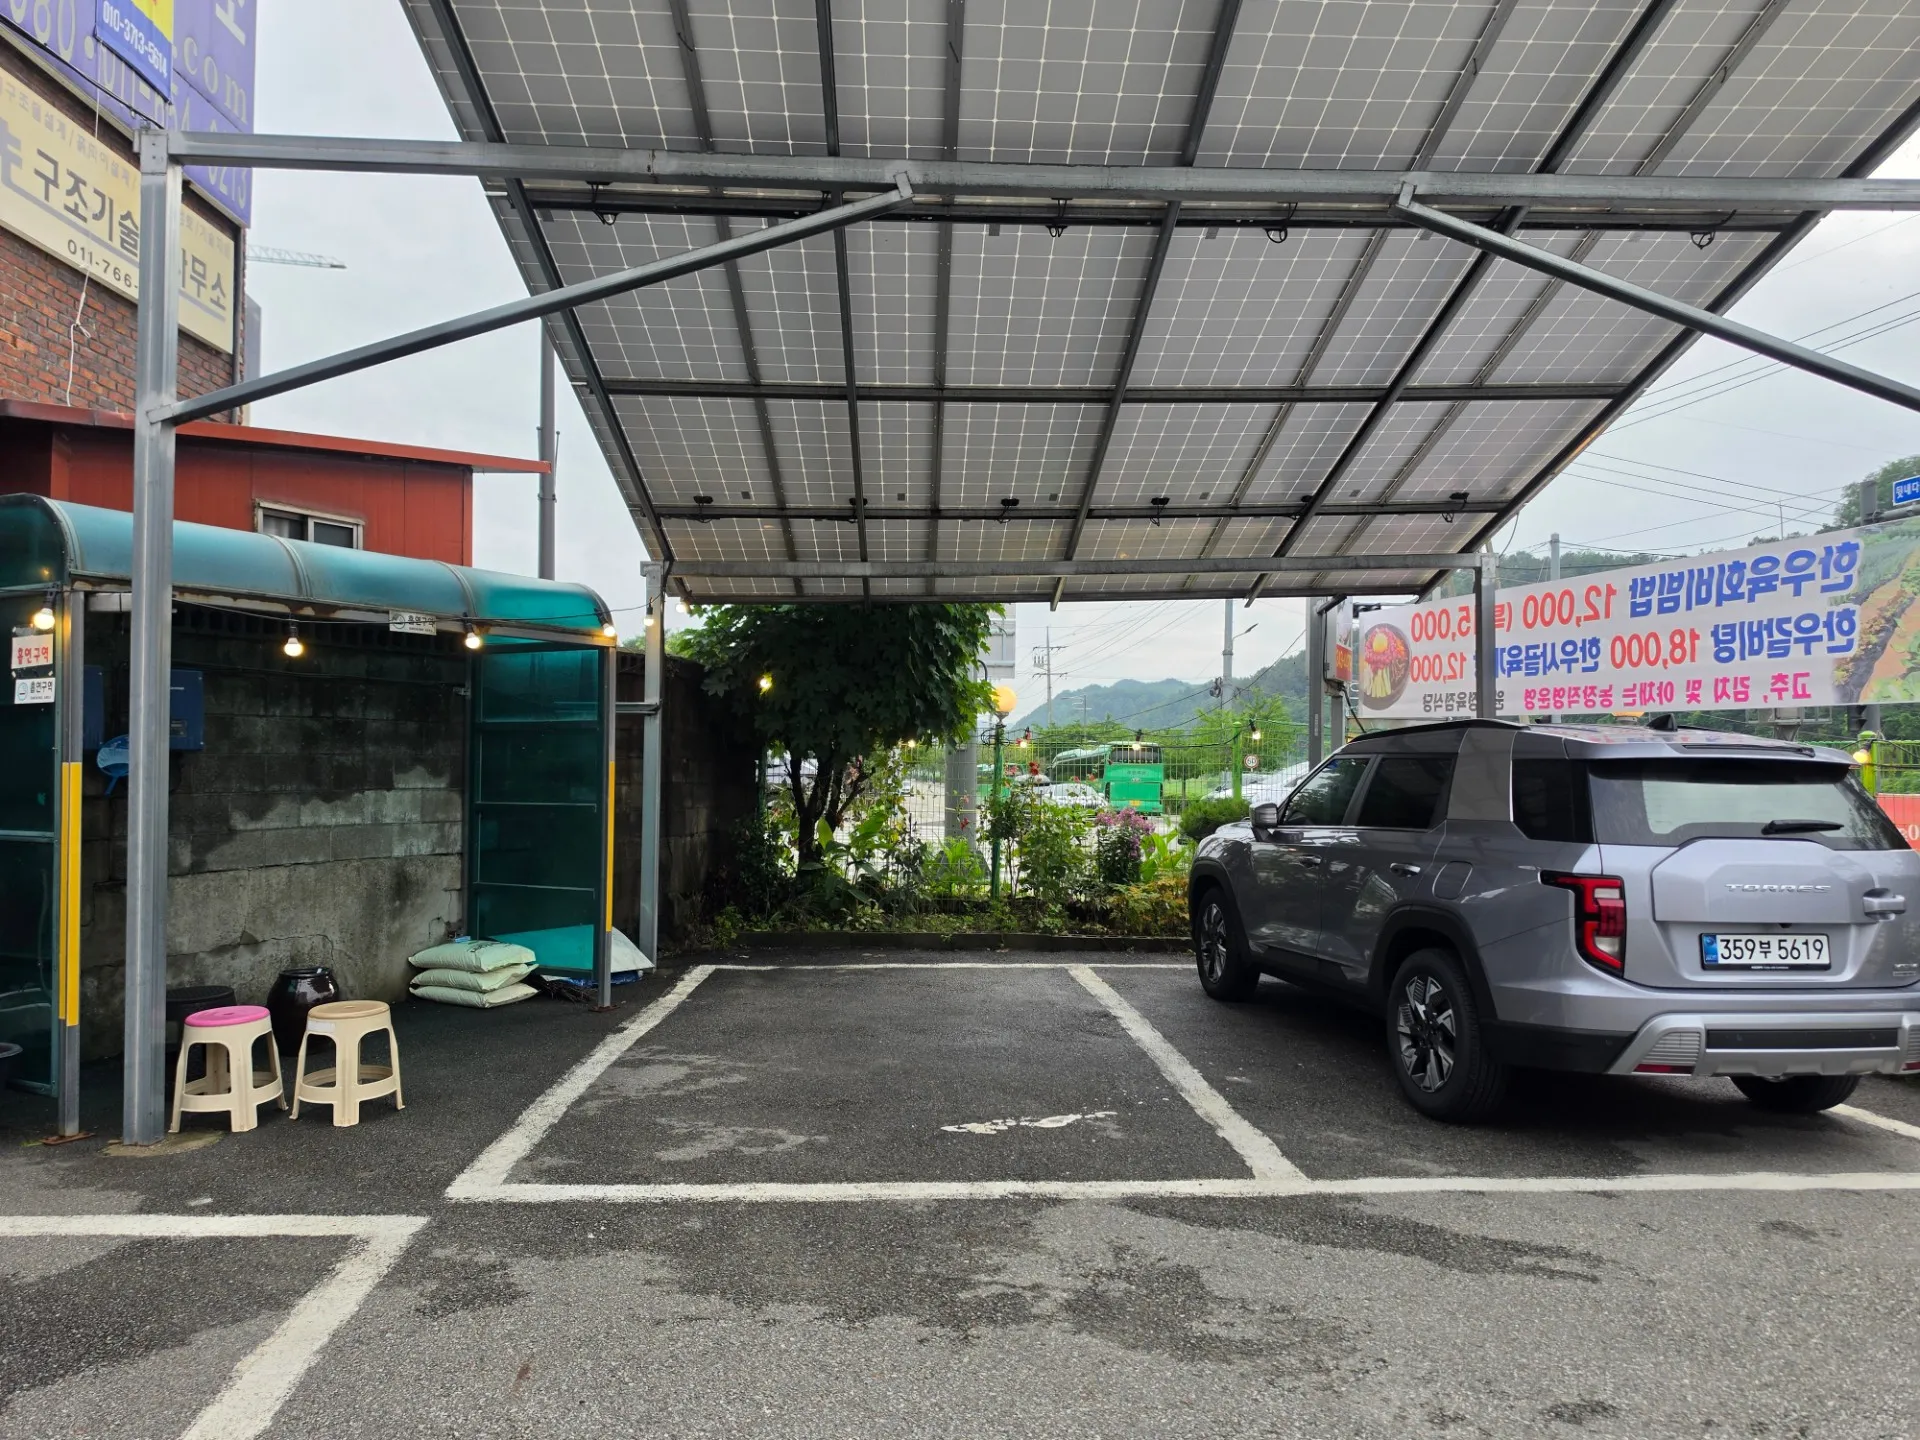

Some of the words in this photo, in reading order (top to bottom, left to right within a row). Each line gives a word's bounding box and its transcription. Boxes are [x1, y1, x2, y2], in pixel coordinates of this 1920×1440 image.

[103, 1, 168, 79] 010-3713-5614
[30, 681, 53, 694] 흡연구역
[1724, 883, 1831, 893] TORRES
